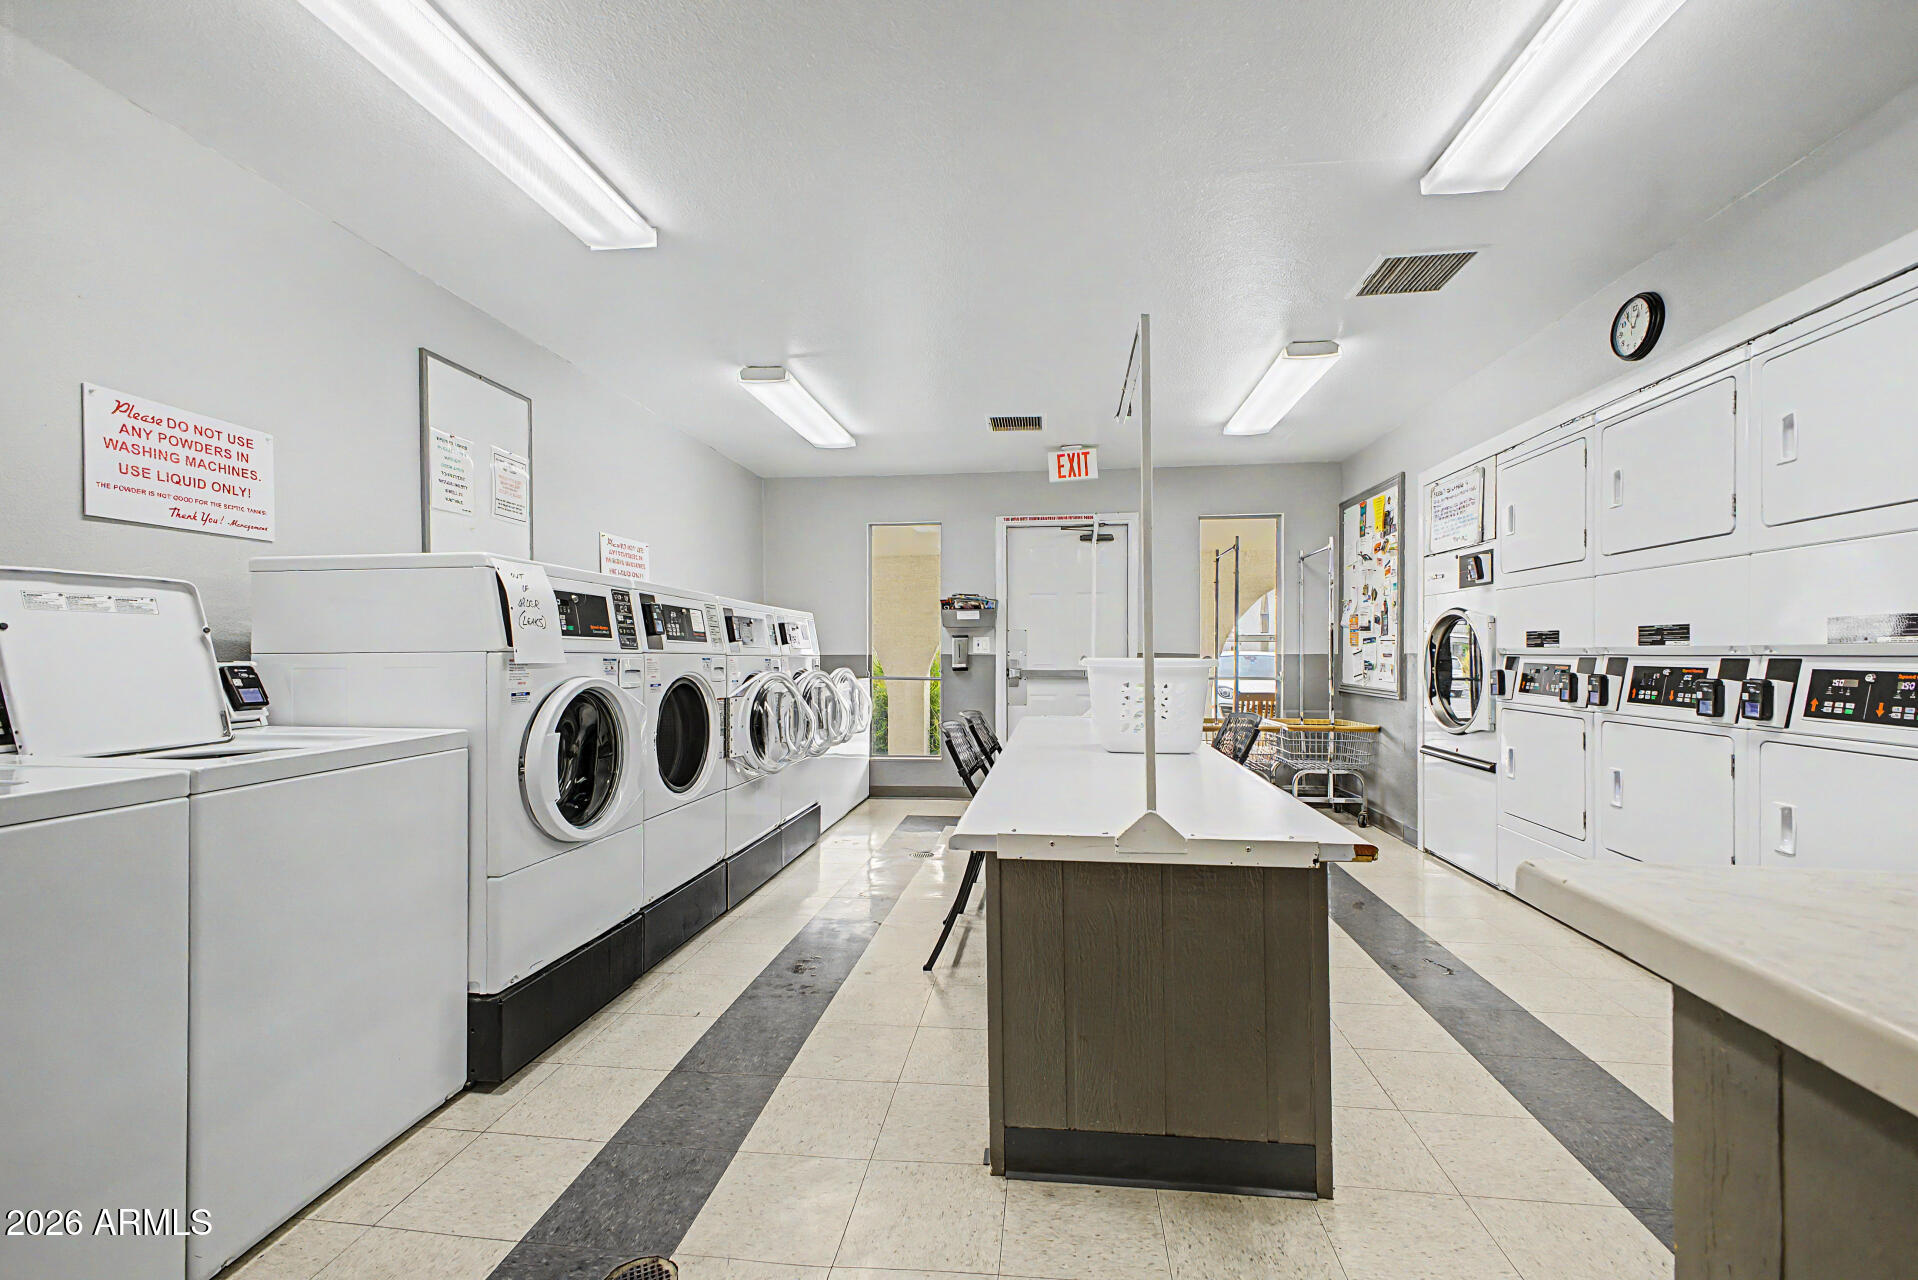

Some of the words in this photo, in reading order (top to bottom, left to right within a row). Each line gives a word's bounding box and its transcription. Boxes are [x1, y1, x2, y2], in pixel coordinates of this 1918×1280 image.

[111, 399, 163, 427] Please
[167, 417, 189, 433] DO
[193, 424, 223, 441] NOT
[227, 433, 255, 450] USE
[103, 436, 181, 464] WASHING
[185, 455, 262, 482] MACHINES.
[119, 423, 153, 440] ANY
[158, 432, 232, 460] POWDERS
[236, 450, 249, 464] IN
[118, 462, 152, 480] USE
[157, 470, 207, 490] LIQUID
[211, 481, 252, 499] ONLY!
[1056, 451, 1091, 479] EXIT
[96, 481, 111, 490] THE
[113, 484, 147, 496] POWDER
[194, 498, 209, 506] FOR
[210, 501, 222, 509] THE
[168, 507, 198, 521] Thank
